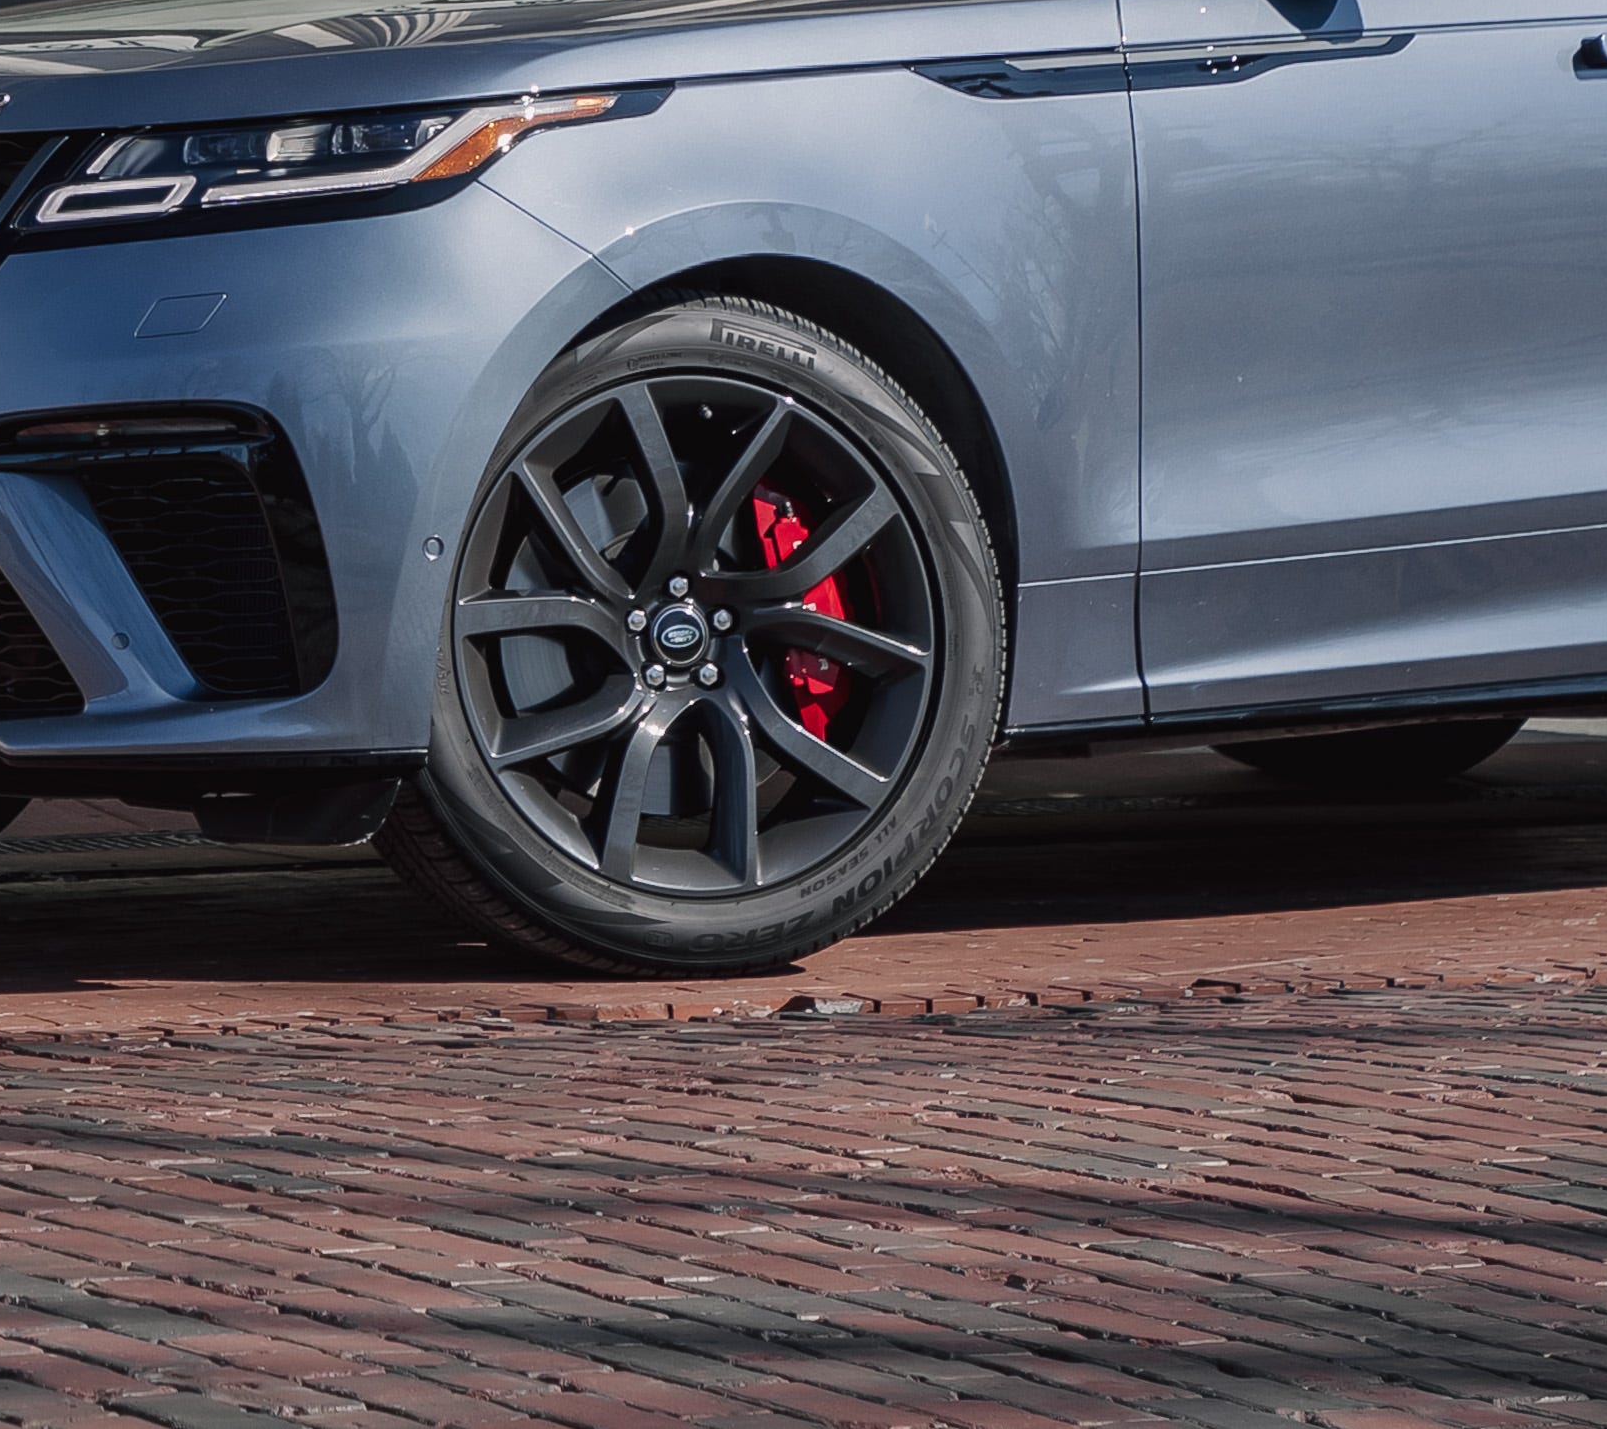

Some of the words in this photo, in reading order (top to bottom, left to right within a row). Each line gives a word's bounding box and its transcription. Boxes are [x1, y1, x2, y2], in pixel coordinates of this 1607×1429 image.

[710, 318, 817, 371] PIRELLI
[832, 714, 977, 918] SCORPION
[874, 815, 898, 846] ALL
[799, 847, 870, 900] SEASON
[689, 911, 815, 953] ZERO
